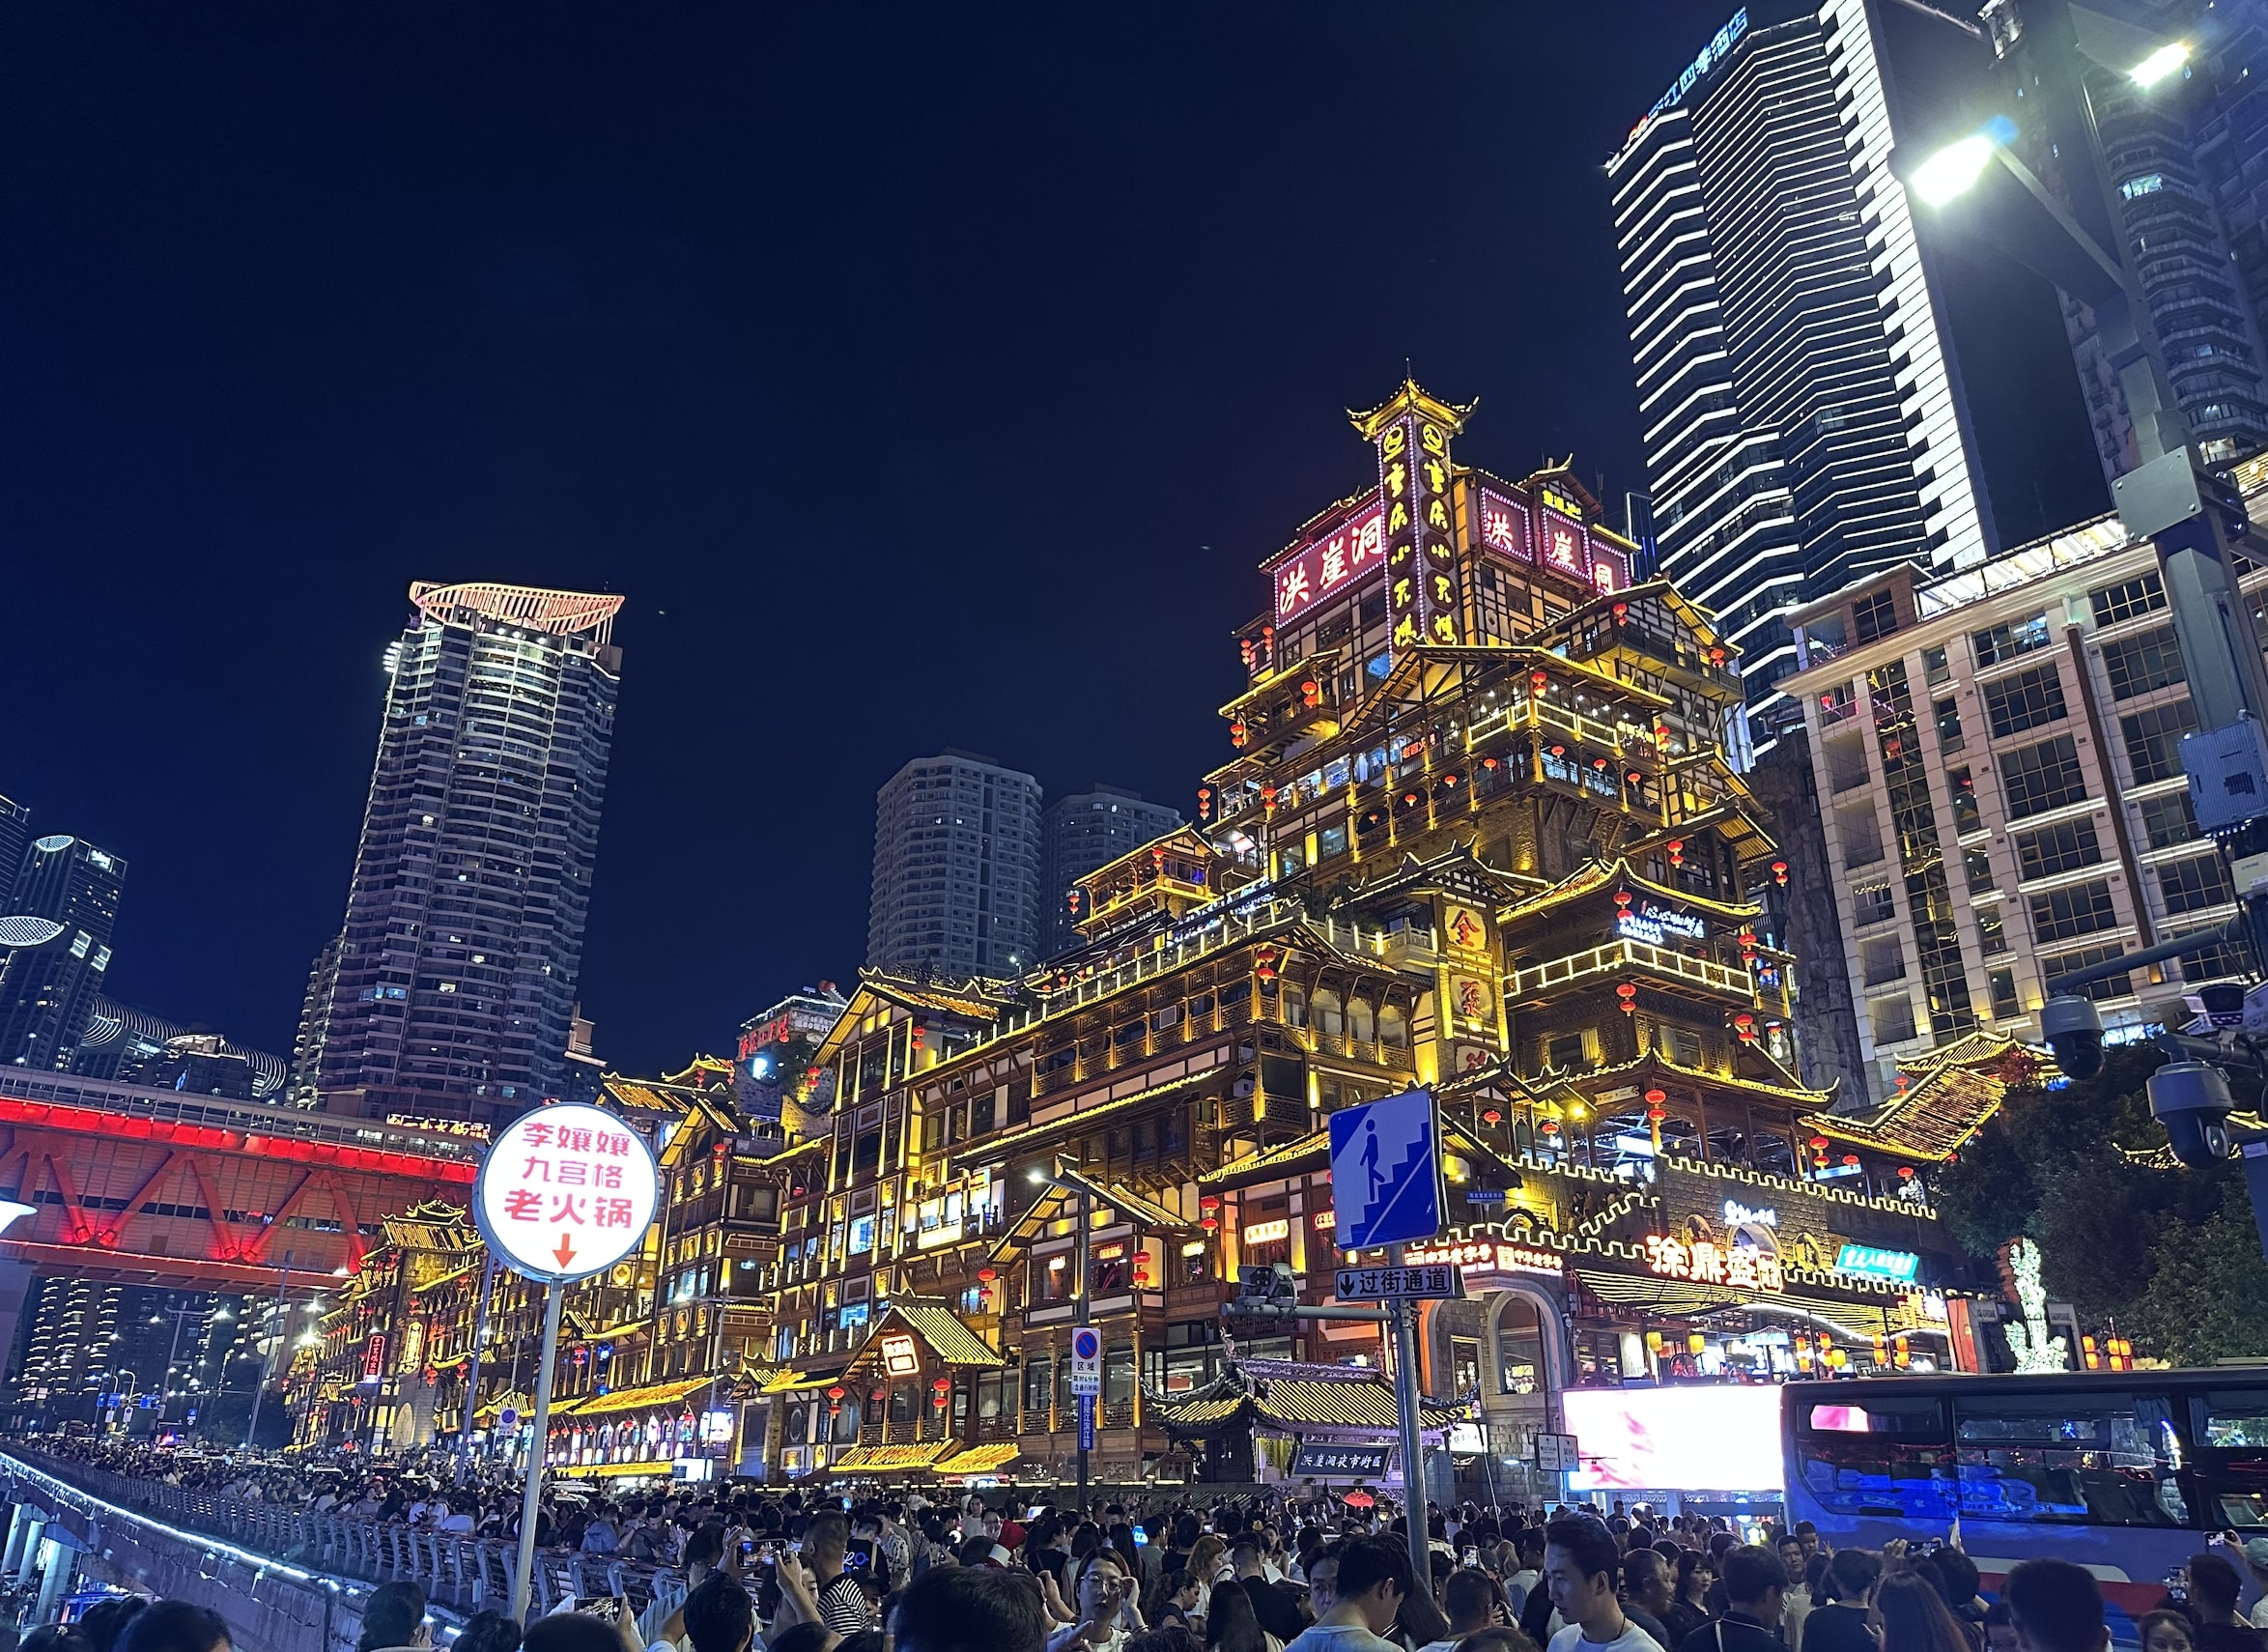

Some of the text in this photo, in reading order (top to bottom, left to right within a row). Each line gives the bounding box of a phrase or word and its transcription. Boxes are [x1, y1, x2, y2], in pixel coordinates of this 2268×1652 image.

[1280, 514, 1383, 614] 洪崖洞
[523, 1123, 631, 1156] 李孃孃
[522, 1156, 623, 1189] 九宫格
[504, 1189, 633, 1229] 老火锅
[1359, 1267, 1448, 1295] 过街通道
[1077, 1361, 1094, 1372] 区域
[1083, 1396, 1091, 1448] 嘉陵江滨江路
